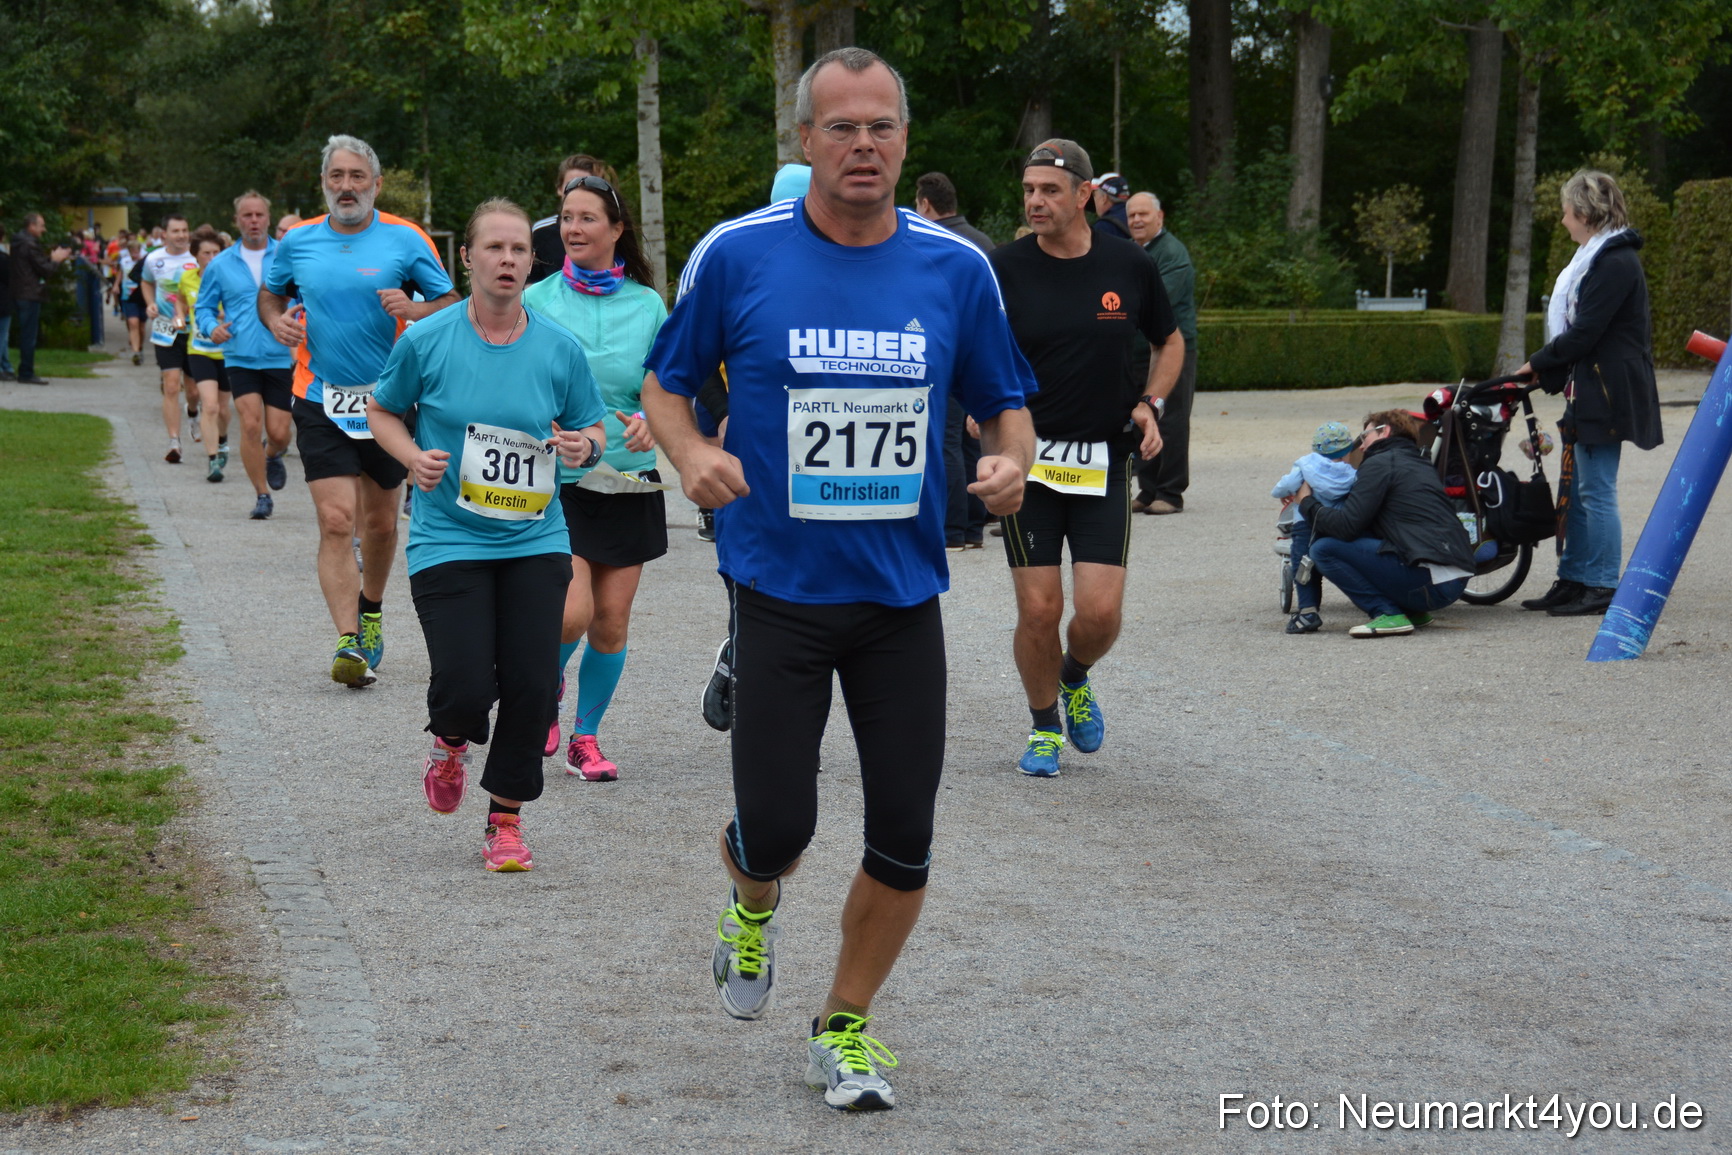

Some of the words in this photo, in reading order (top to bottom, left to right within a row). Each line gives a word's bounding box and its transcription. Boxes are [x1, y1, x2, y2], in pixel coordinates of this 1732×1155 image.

[789, 328, 927, 363] HUBER
[819, 360, 921, 376] TECHNOLOGY
[793, 401, 840, 414] PARTL
[843, 401, 909, 414] Neumarkt
[468, 431, 501, 445] PARTL
[502, 437, 546, 455] Neumarkt
[804, 420, 917, 468] 2175
[1039, 439, 1093, 465] 270
[482, 448, 536, 487] 301
[1044, 469, 1082, 483] Walter
[484, 490, 527, 509] Kerstin
[819, 481, 900, 501] Christian
